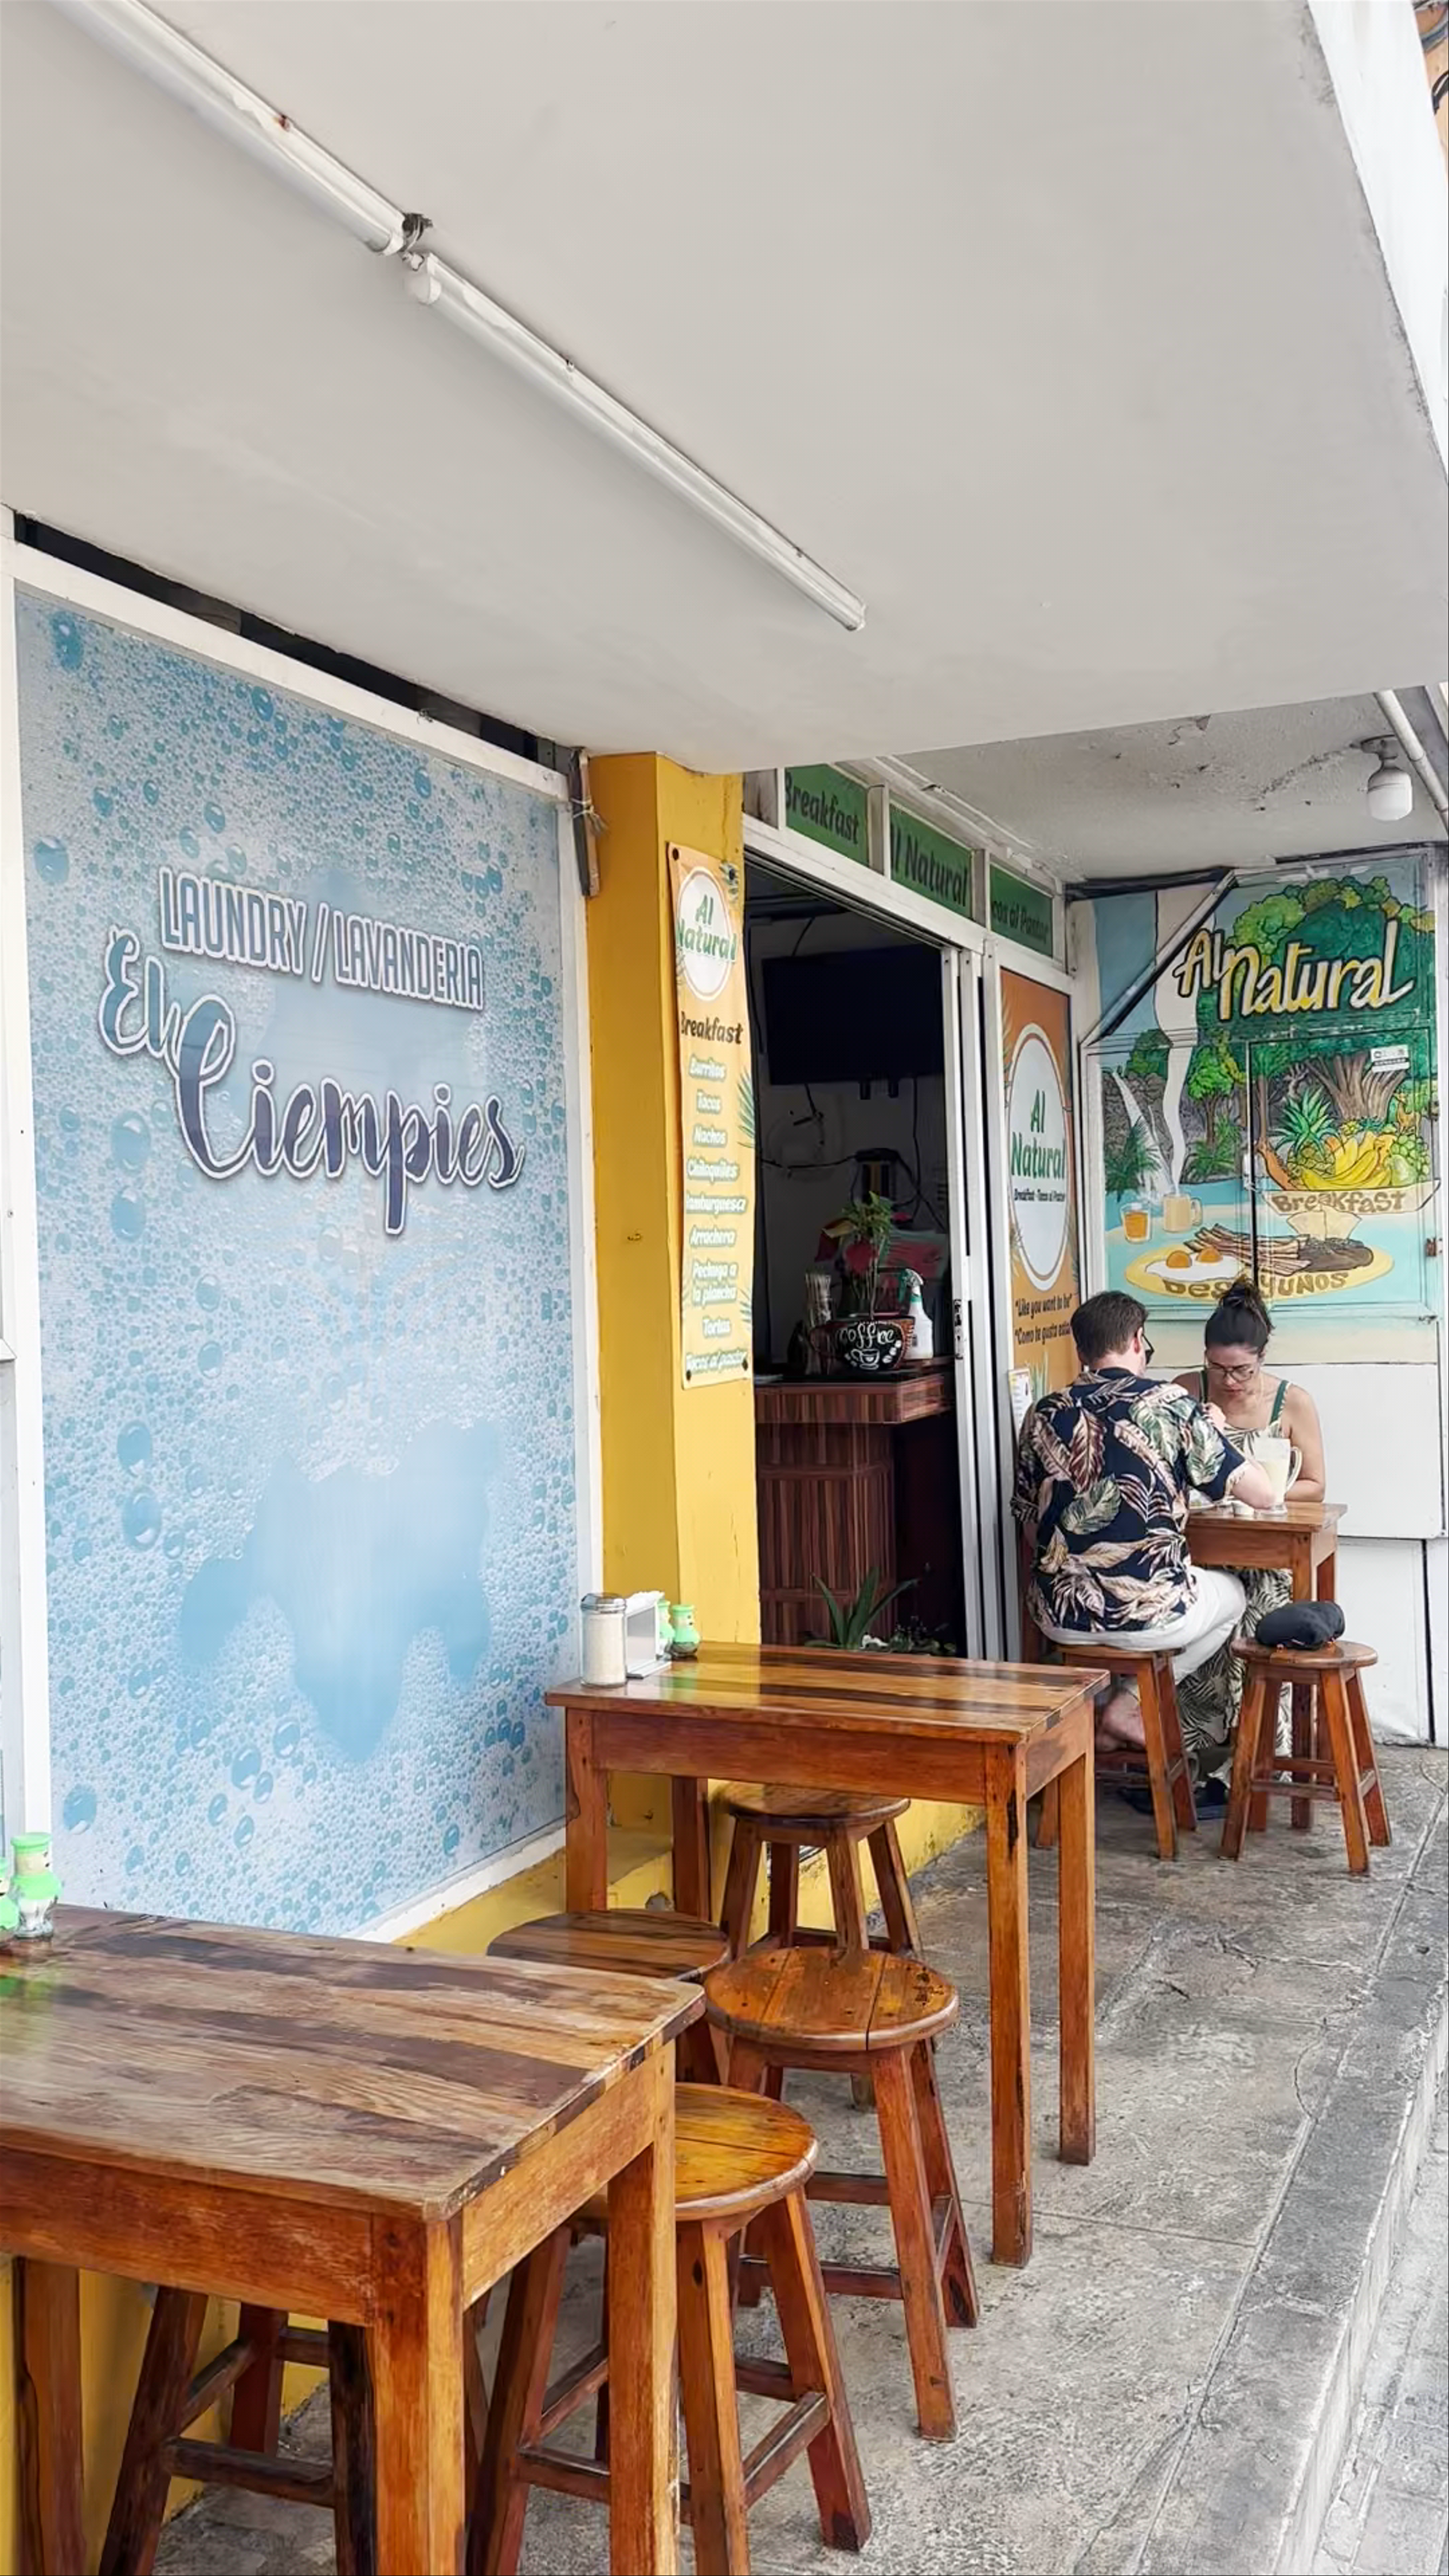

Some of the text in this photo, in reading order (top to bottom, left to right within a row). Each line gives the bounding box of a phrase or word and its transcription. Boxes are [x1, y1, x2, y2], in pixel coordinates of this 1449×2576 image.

[785, 772, 859, 845] Breakfast
[906, 834, 968, 907] Natural
[160, 867, 306, 974] LAUNDRY
[334, 910, 483, 1010] LAVANDERIA
[676, 918, 737, 961] Natural
[695, 894, 714, 925] Al
[98, 923, 180, 1057] El
[1173, 927, 1229, 998] Al
[173, 994, 525, 1235] Ciempies
[1031, 1089, 1045, 1133] Al
[1012, 1132, 1065, 1180] Natural
[1031, 1301, 1041, 1319] you
